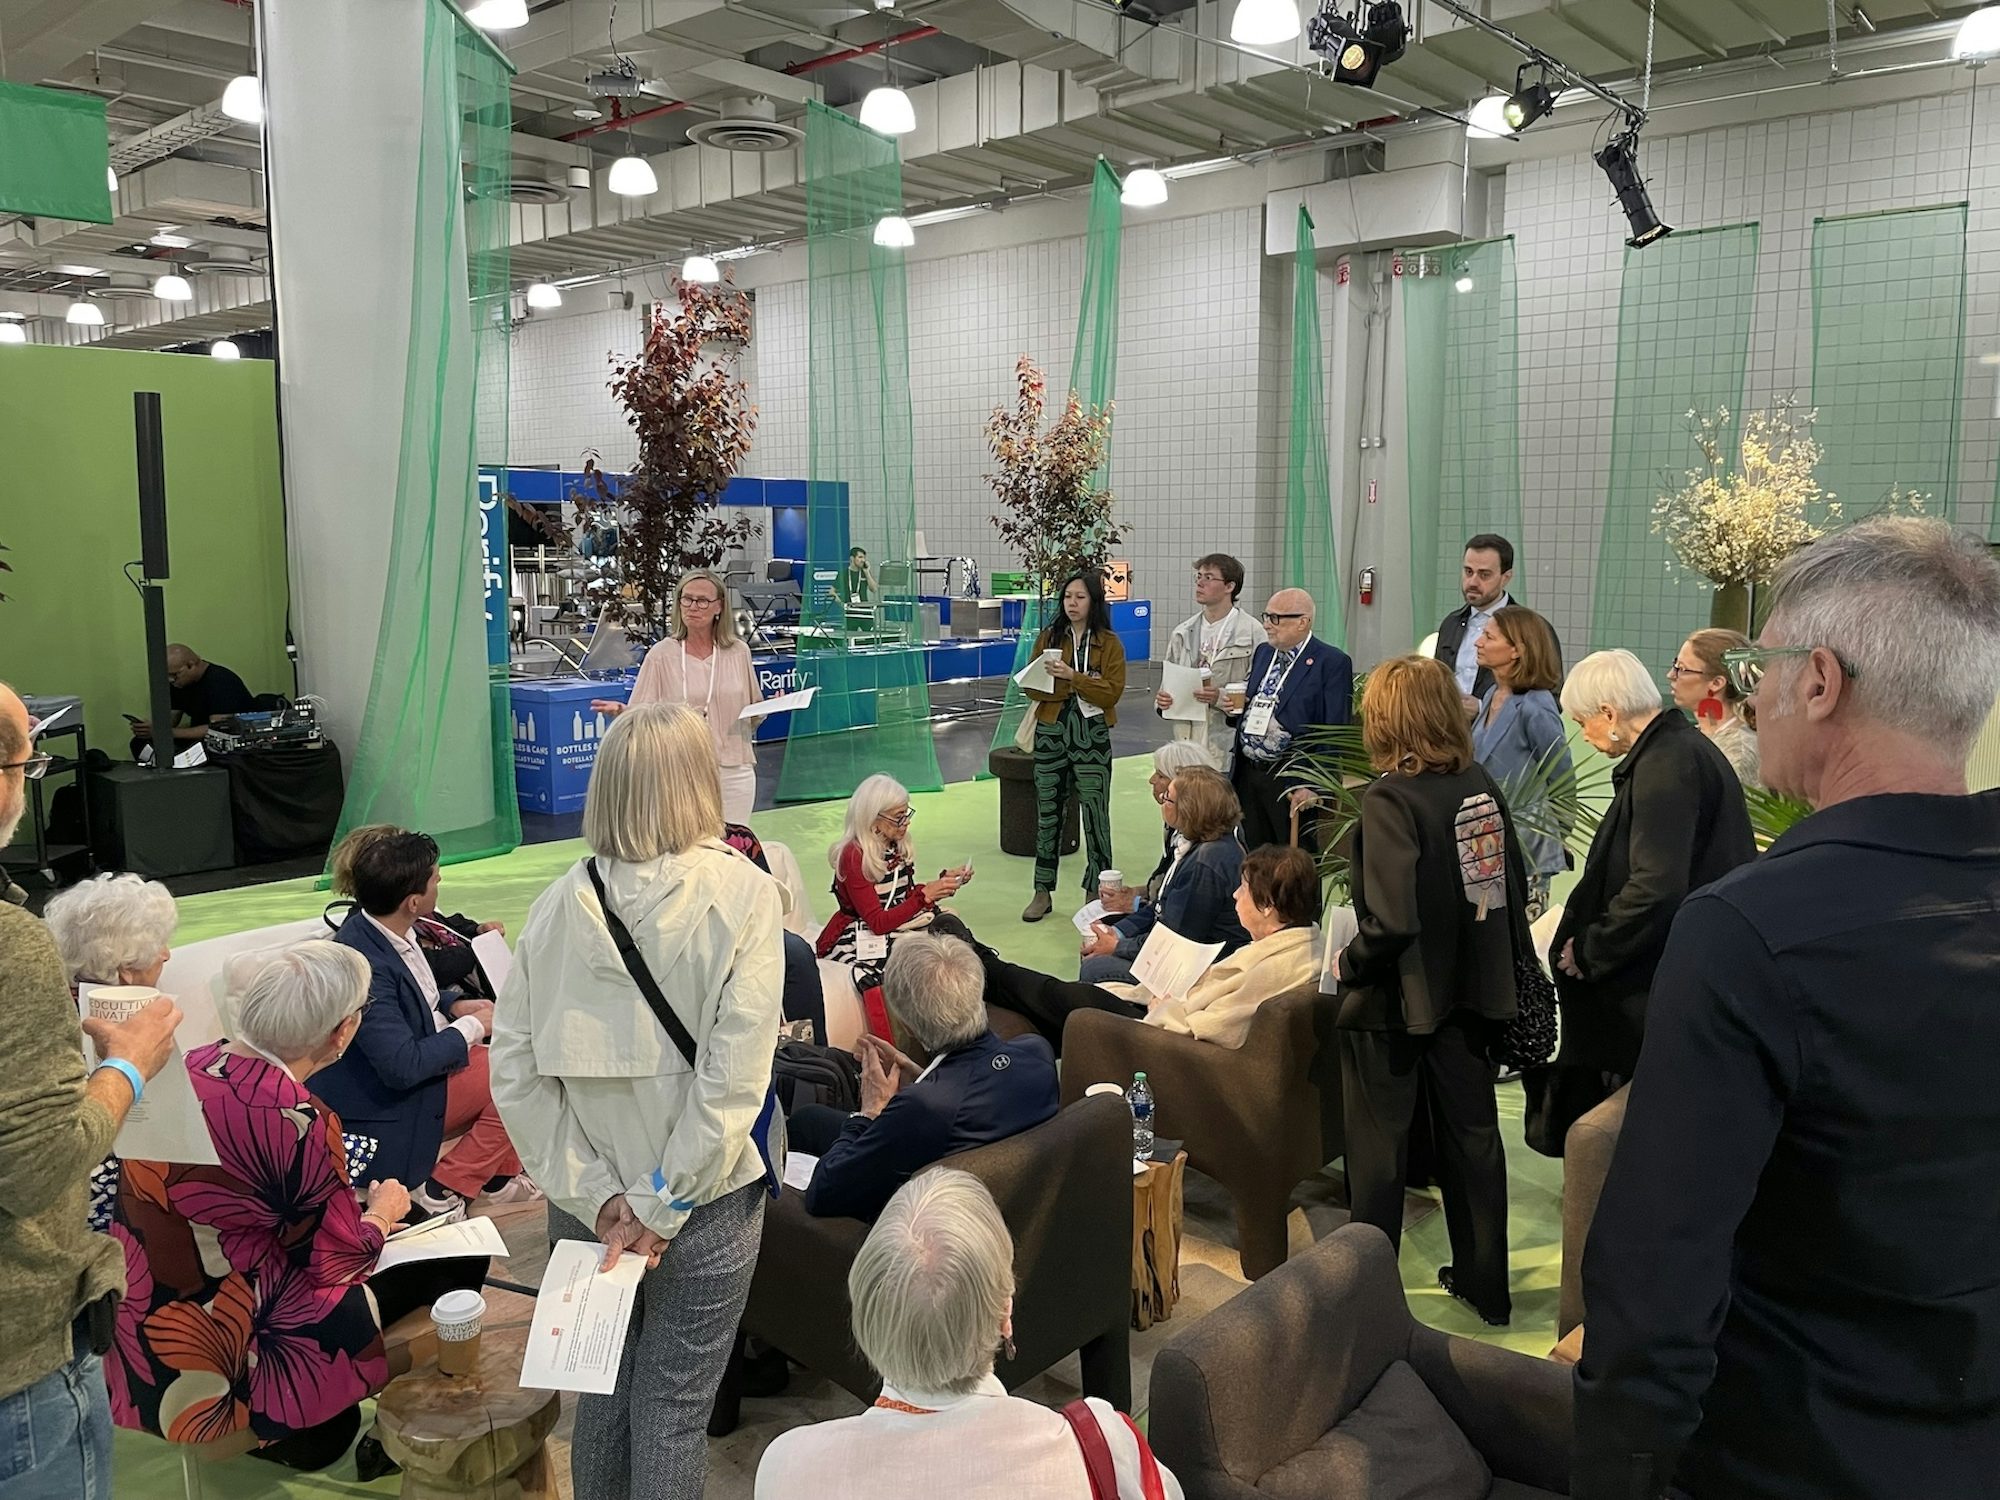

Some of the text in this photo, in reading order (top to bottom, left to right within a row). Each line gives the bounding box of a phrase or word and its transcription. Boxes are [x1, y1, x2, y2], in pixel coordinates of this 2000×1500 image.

[760, 668, 808, 690] Rarify
[556, 743, 592, 755] BOTTLES
[562, 755, 593, 764] BOTELLAS
